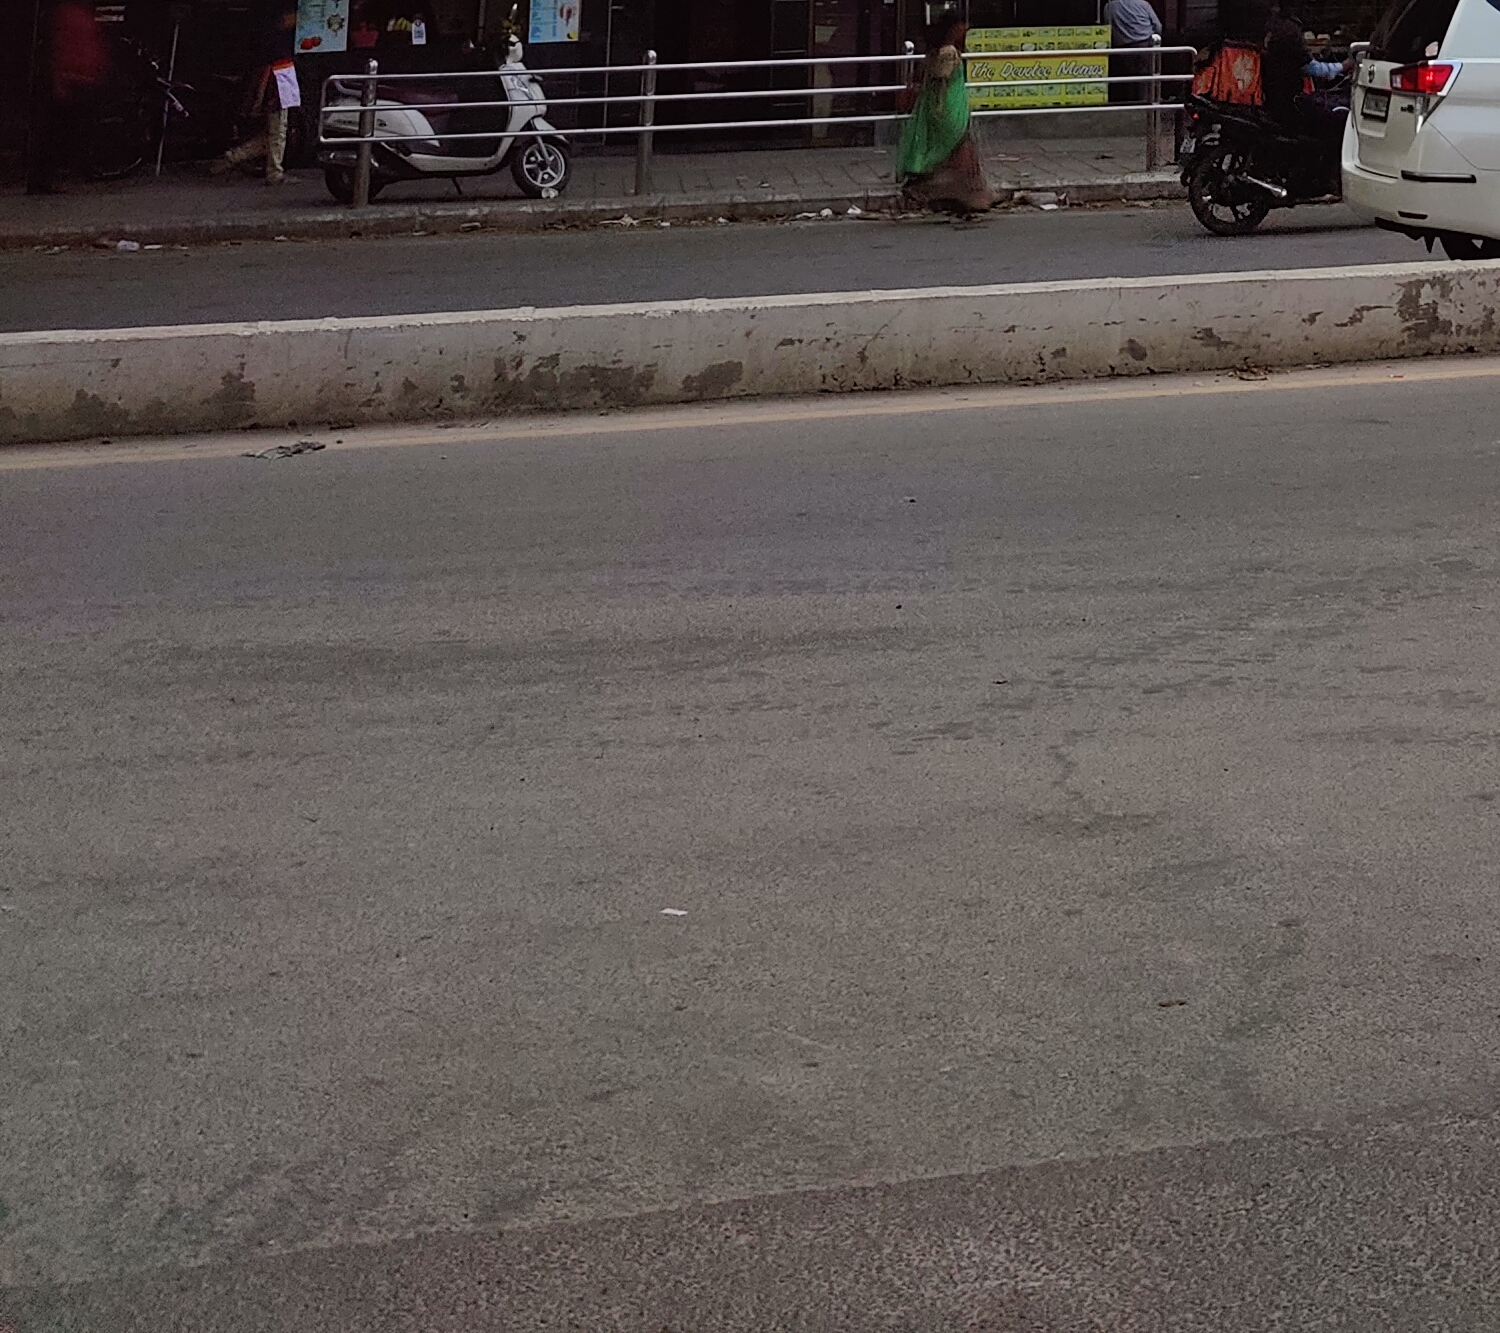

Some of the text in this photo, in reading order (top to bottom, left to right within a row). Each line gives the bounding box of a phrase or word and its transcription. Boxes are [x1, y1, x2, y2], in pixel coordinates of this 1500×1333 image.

[971, 60, 1105, 79] The Devotee Momos
